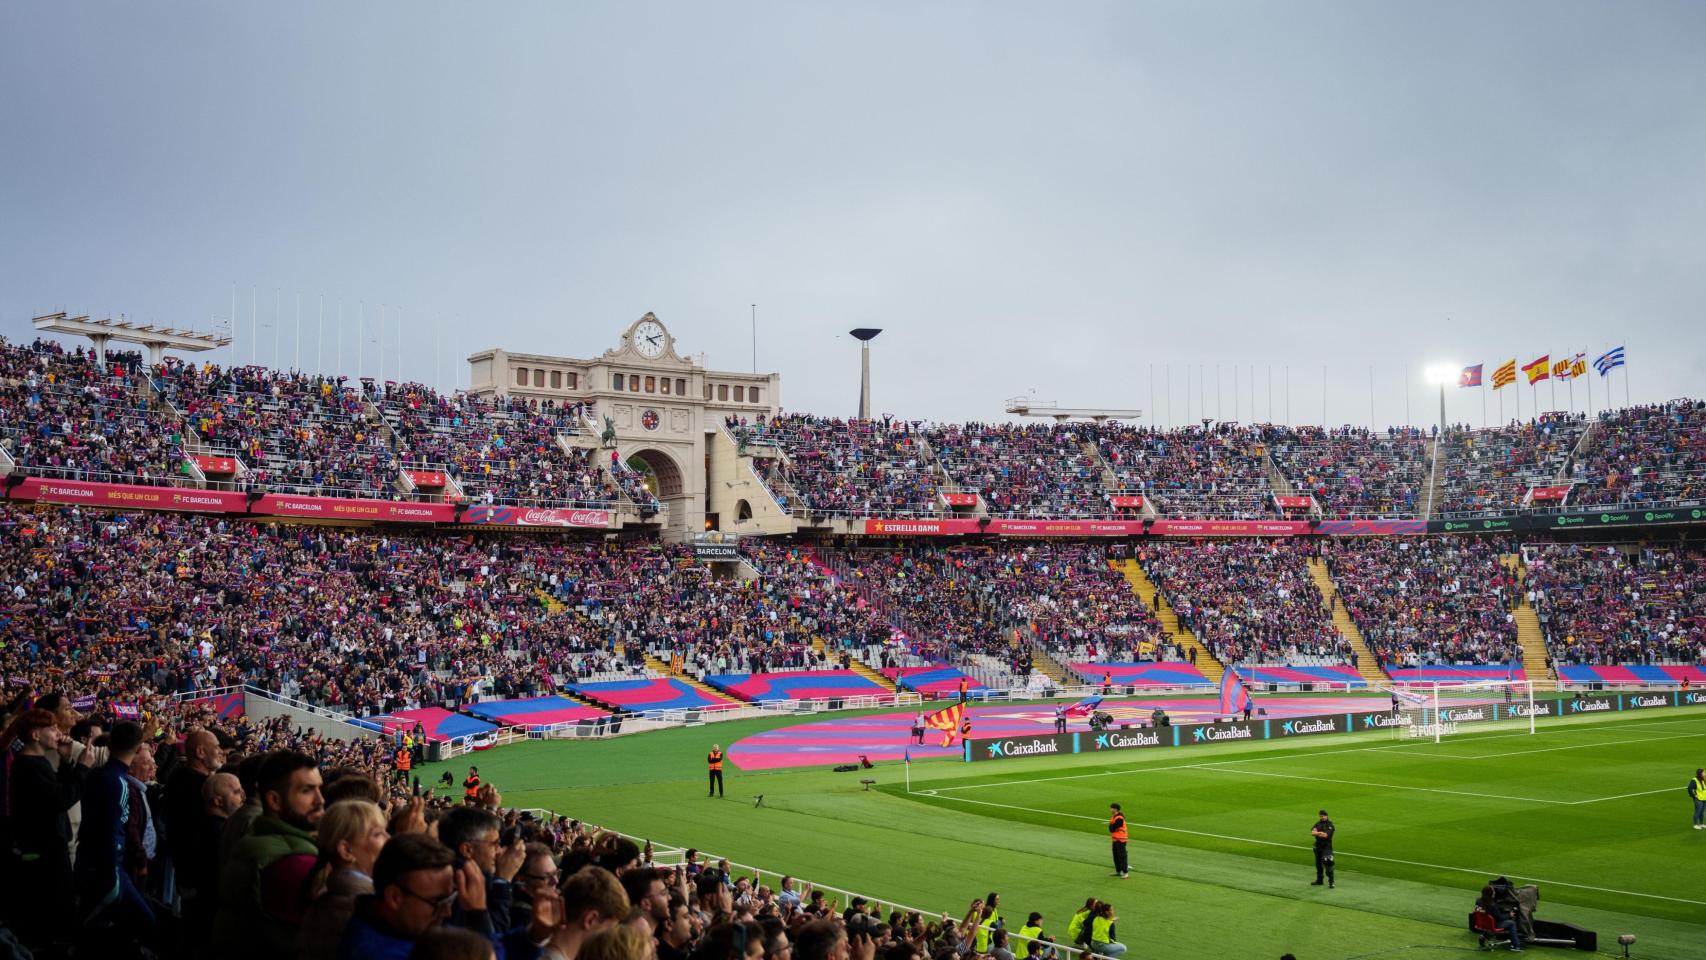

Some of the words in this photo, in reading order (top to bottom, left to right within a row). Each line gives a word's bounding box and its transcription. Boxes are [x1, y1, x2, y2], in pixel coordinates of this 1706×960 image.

[49, 487, 58, 495] FC
[58, 488, 94, 497] BARCELONA
[122, 492, 134, 500] QUE
[190, 497, 223, 505] BARCELONA
[291, 503, 322, 511] BARCELONA
[404, 508, 433, 516] BARCELONA
[1654, 512, 1674, 520] Spotify
[884, 524, 917, 532] ESTRELLA
[918, 524, 940, 532] DAMM
[1452, 522, 1470, 530] Spotify
[1492, 520, 1509, 528] Spotify
[1579, 699, 1610, 712] CaixaBank
[1638, 695, 1668, 707] CaixaBank
[1448, 708, 1484, 721] CaixaBank
[1374, 713, 1413, 727] CaixaBank
[1294, 719, 1335, 734] CaixaBank
[1206, 725, 1252, 741] CaixaBank
[1110, 732, 1160, 748] CaixaBank
[1004, 738, 1058, 755] CaixaBank
